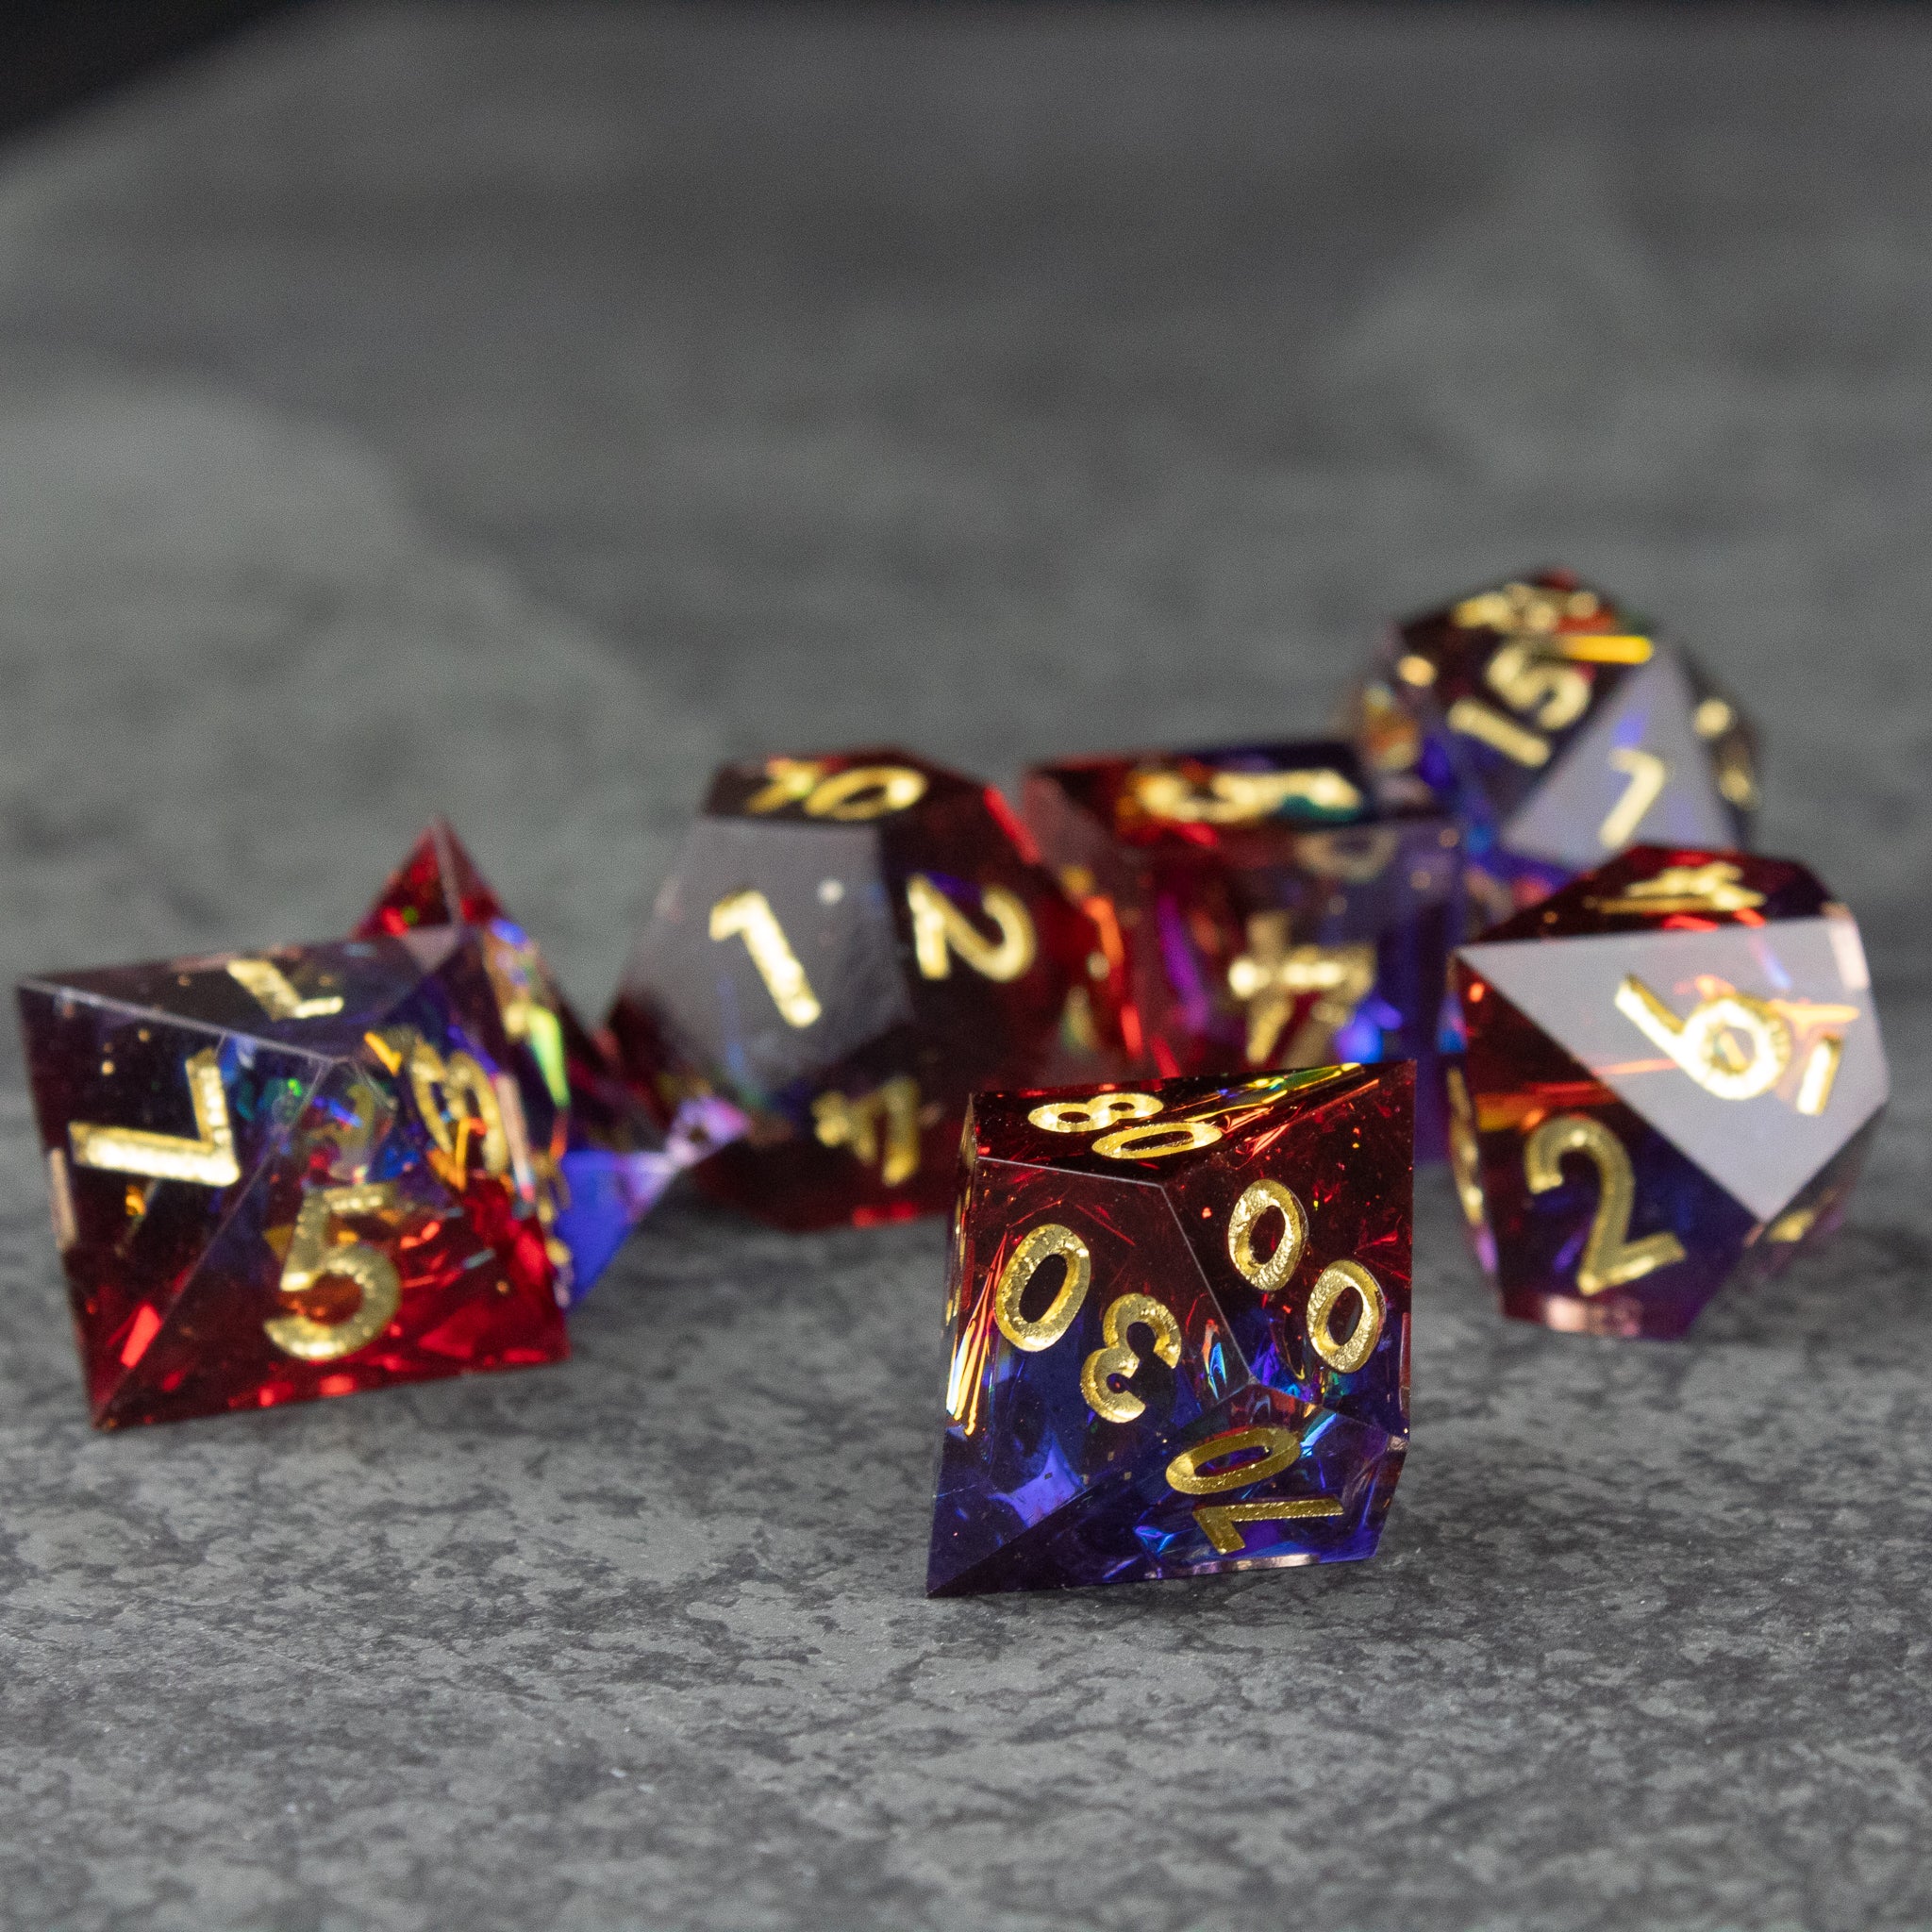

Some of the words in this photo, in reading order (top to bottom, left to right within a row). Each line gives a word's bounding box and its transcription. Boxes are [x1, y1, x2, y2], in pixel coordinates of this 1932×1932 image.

[1446, 643, 1591, 769] 15
[908, 874, 1036, 984] 2
[1027, 1092, 1223, 1159] 80
[263, 1182, 402, 1360] 5
[1228, 1178, 1387, 1374] 00
[1524, 1117, 1687, 1296] 2
[994, 1224, 1182, 1424] 30
[1165, 1425, 1344, 1555] 10
